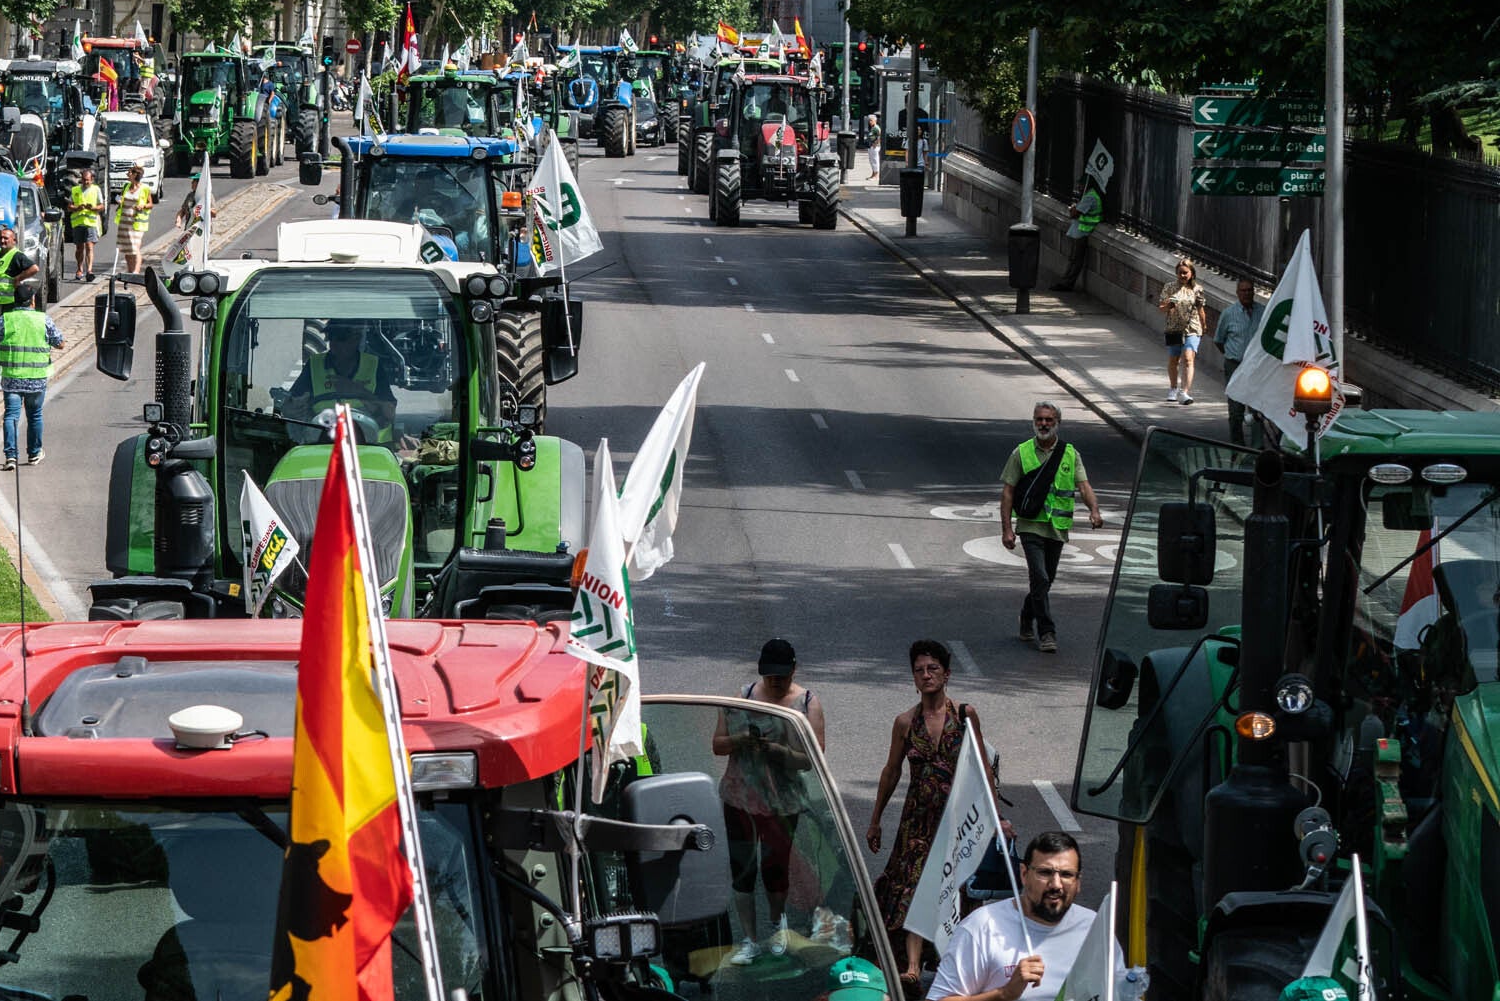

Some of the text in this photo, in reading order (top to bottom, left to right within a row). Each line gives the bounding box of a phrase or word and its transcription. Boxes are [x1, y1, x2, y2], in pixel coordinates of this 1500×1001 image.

[1286, 142, 1325, 153] Cibele
[251, 520, 277, 569] CAMPESINOS
[581, 571, 624, 611] NION
